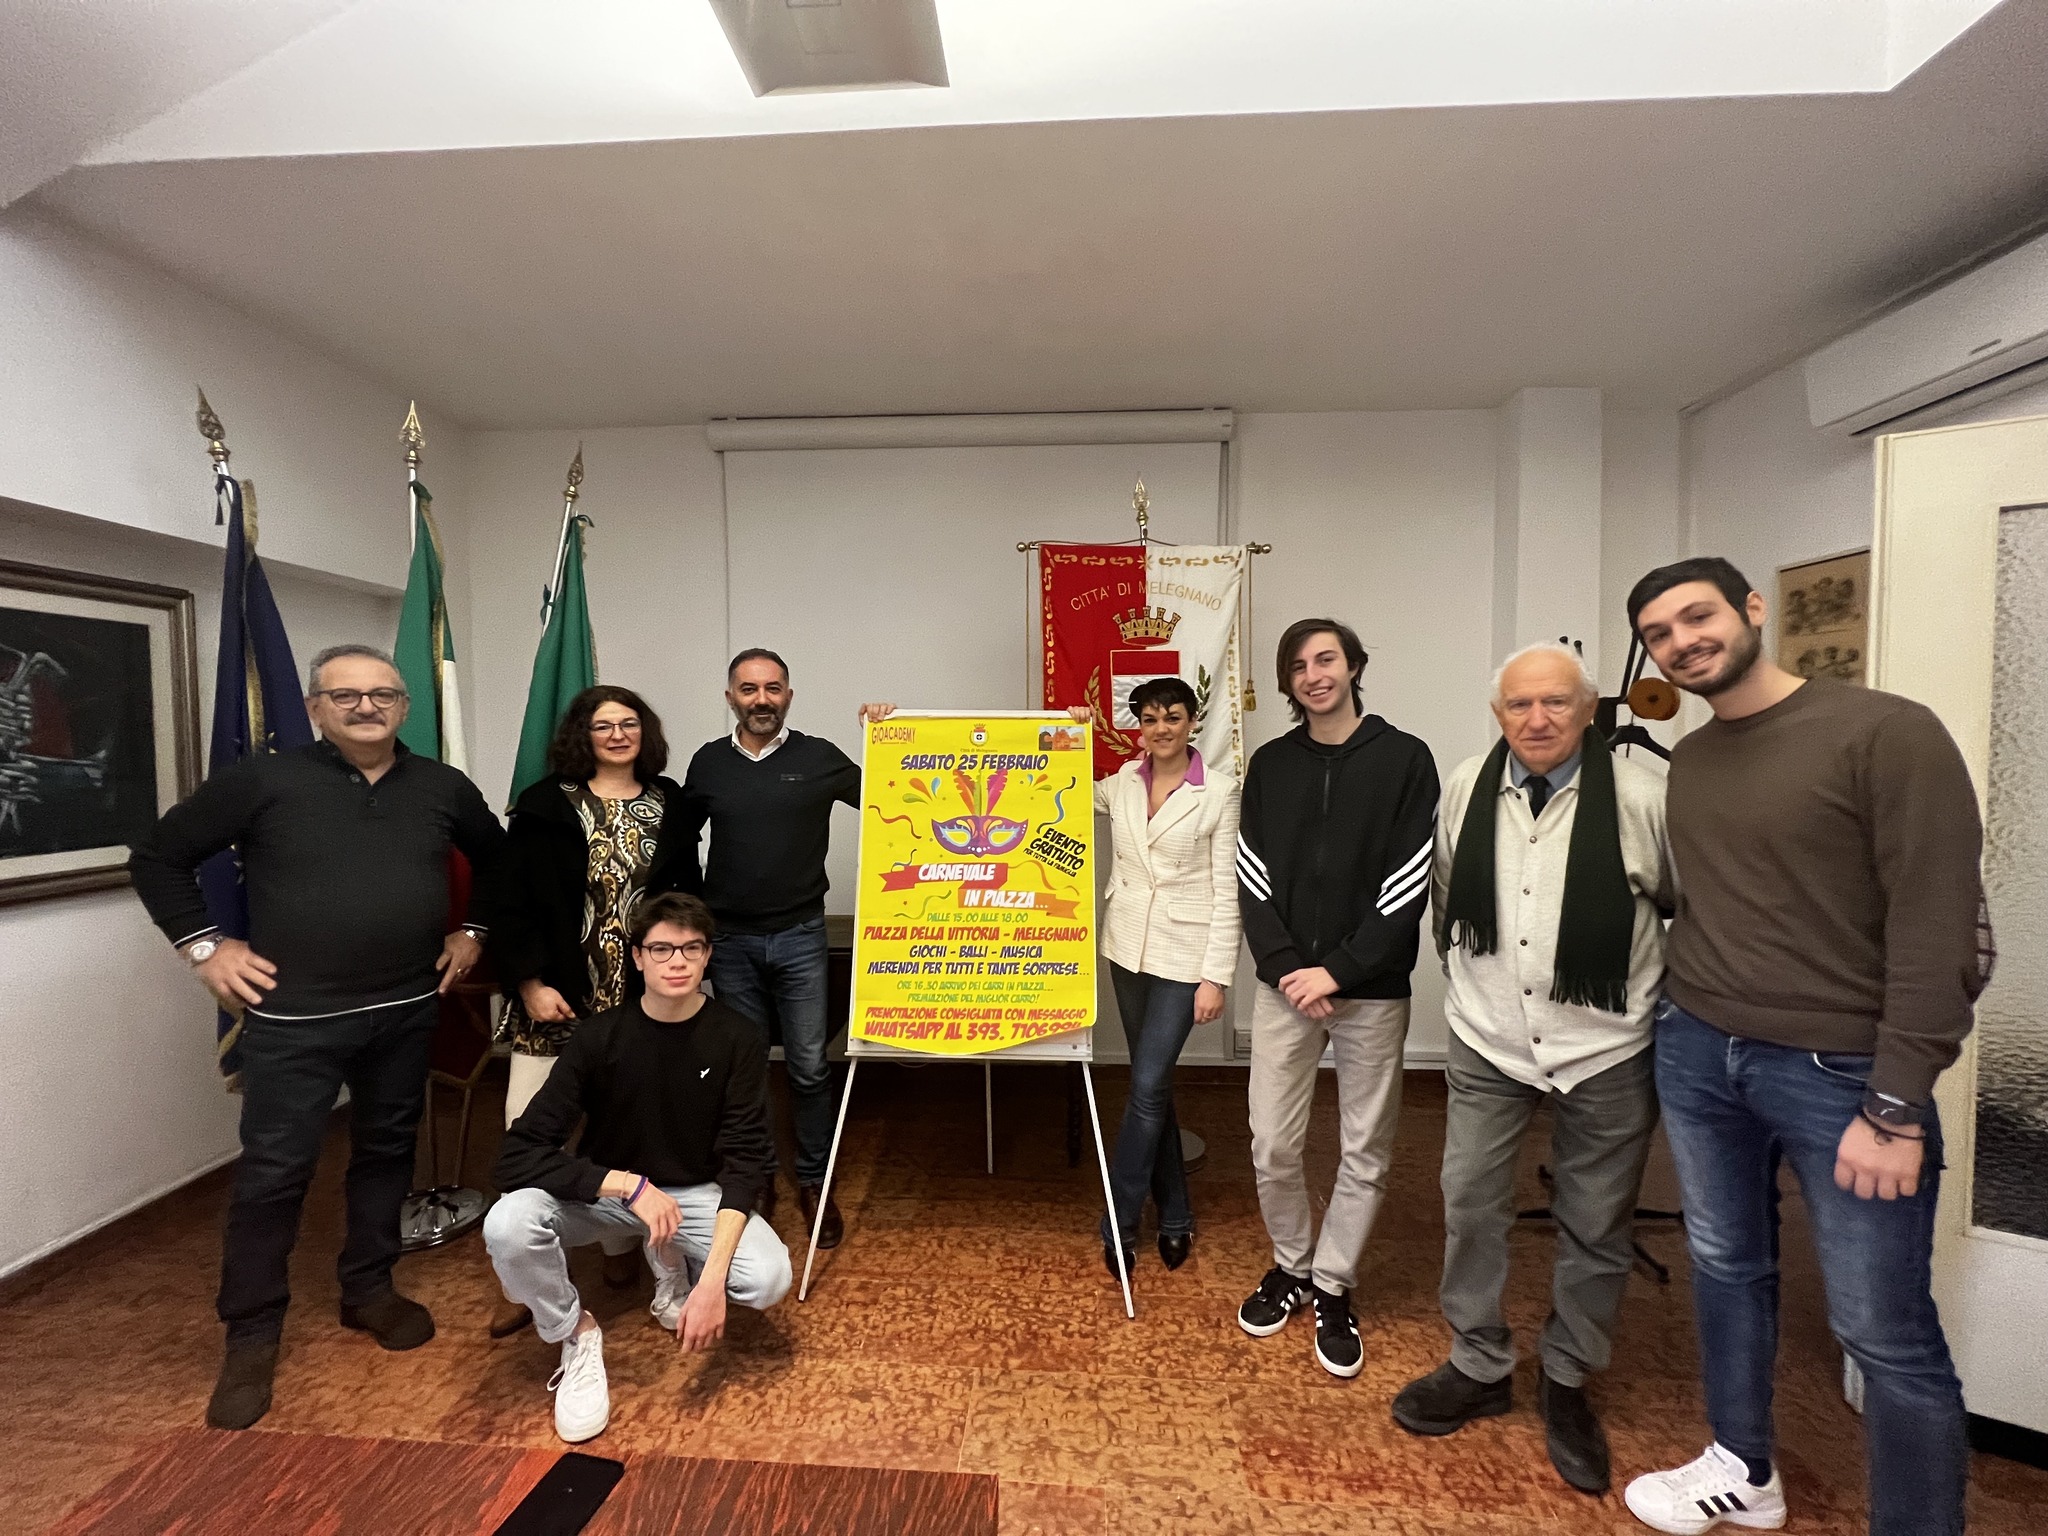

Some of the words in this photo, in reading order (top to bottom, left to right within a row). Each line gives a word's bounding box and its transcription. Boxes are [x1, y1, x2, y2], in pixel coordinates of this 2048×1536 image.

[1117, 582, 1131, 596] DI
[1138, 580, 1222, 611] MELEGNANO
[871, 726, 917, 744] GIOACADEMY
[900, 753, 956, 771] SABATO
[958, 754, 978, 770] 25
[980, 753, 1049, 771] FEBBRAIO
[1042, 827, 1087, 856] EVENTO
[1029, 837, 1085, 870] GRATUITO
[918, 863, 996, 882] CARNEVALE
[963, 889, 981, 907] IN
[927, 912, 951, 922] DALLE
[952, 912, 979, 923] 15.00
[980, 912, 999, 922] ALLE
[1001, 912, 1029, 923] 18.00
[863, 925, 908, 941] PIAZZA
[909, 925, 944, 941] DELLA
[947, 925, 1000, 941] VITTORIA
[1012, 925, 1089, 942] MELEGNANO
[909, 944, 948, 958] GIOCHI
[958, 945, 989, 958] BALLI
[999, 945, 1043, 959] MUSICA
[866, 961, 920, 975] MERENDA
[921, 961, 943, 975] PER
[945, 962, 975, 975] TUTTI
[976, 962, 984, 975] E
[987, 962, 1020, 975] TANTE
[896, 980, 912, 990] ORE
[914, 980, 939, 991] 16.30
[938, 981, 967, 991] ARRIVO
[968, 981, 981, 991] DEI
[982, 981, 1005, 991] CARRI
[1006, 981, 1016, 991] IN
[907, 993, 960, 1003] PREMIAZIONE
[960, 993, 974, 1003] DEL
[975, 993, 1010, 1004] MIGLIOR
[1010, 993, 1040, 1004] CARRO!
[865, 1006, 938, 1020] PRENOTAZIONE
[939, 1007, 1003, 1020] CONSIGLIATA
[1004, 1008, 1026, 1021] CON
[1026, 1008, 1088, 1021] MESSAGGIO
[864, 1020, 944, 1040] WHATSAPP
[943, 1021, 963, 1041] AL
